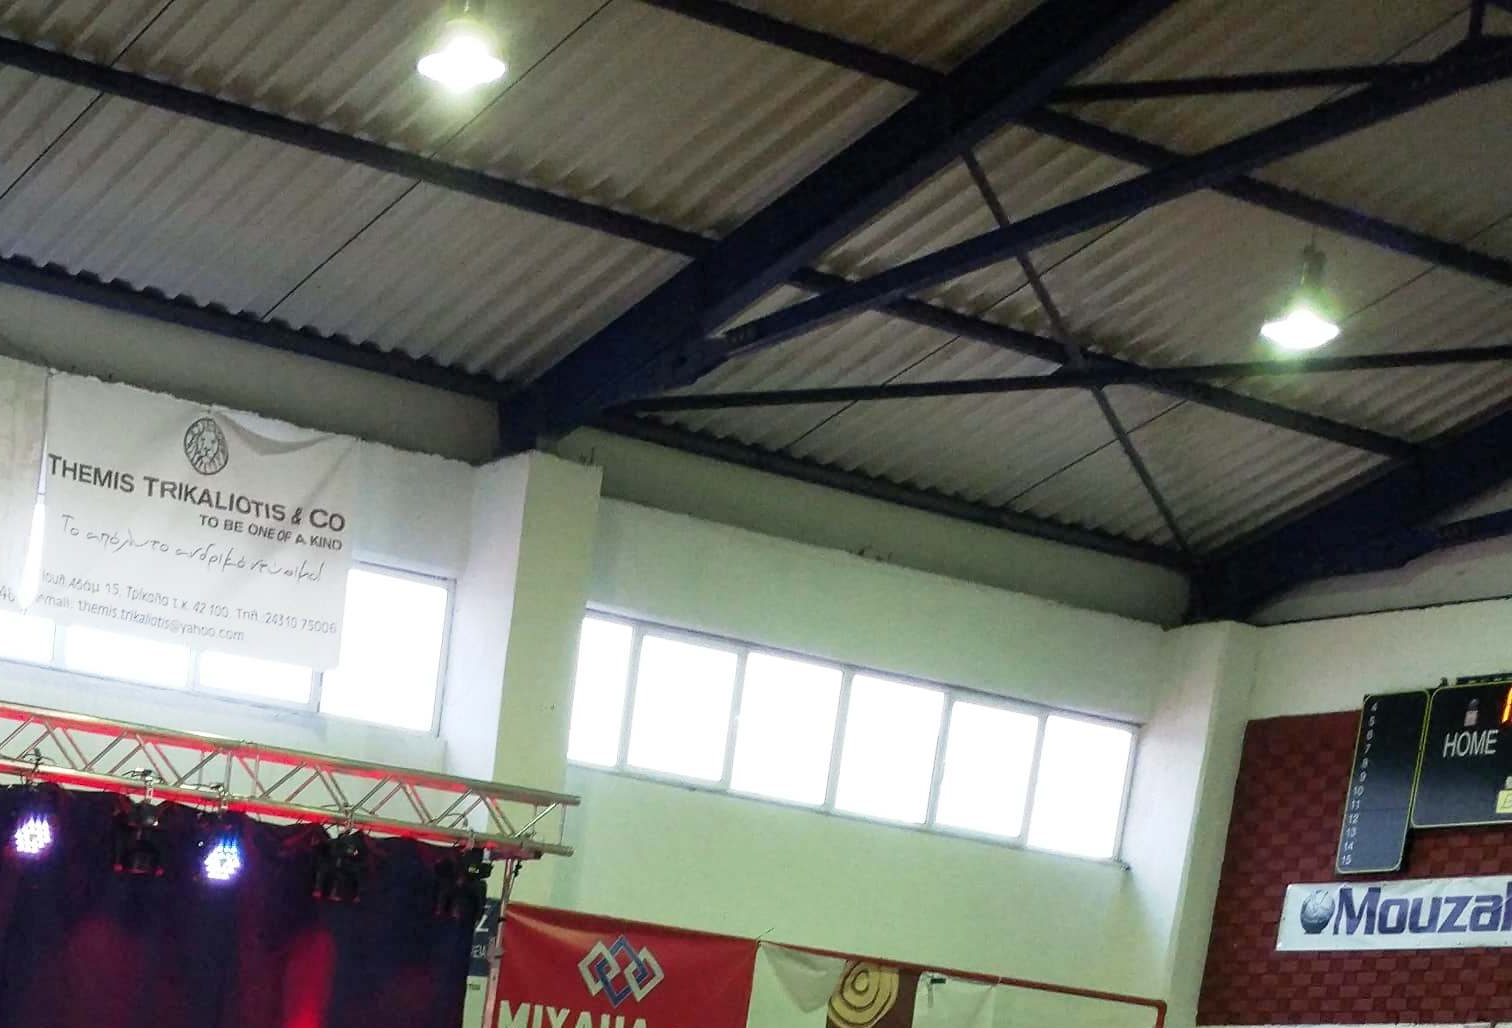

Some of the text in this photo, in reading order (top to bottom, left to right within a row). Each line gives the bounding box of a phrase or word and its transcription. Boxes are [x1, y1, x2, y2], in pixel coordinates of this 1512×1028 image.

[47, 454, 346, 532] THEMIS TRIKALIOTIS & CO
[199, 514, 343, 551] TO BE ONE OF A KIND
[1443, 729, 1498, 758] HOME
